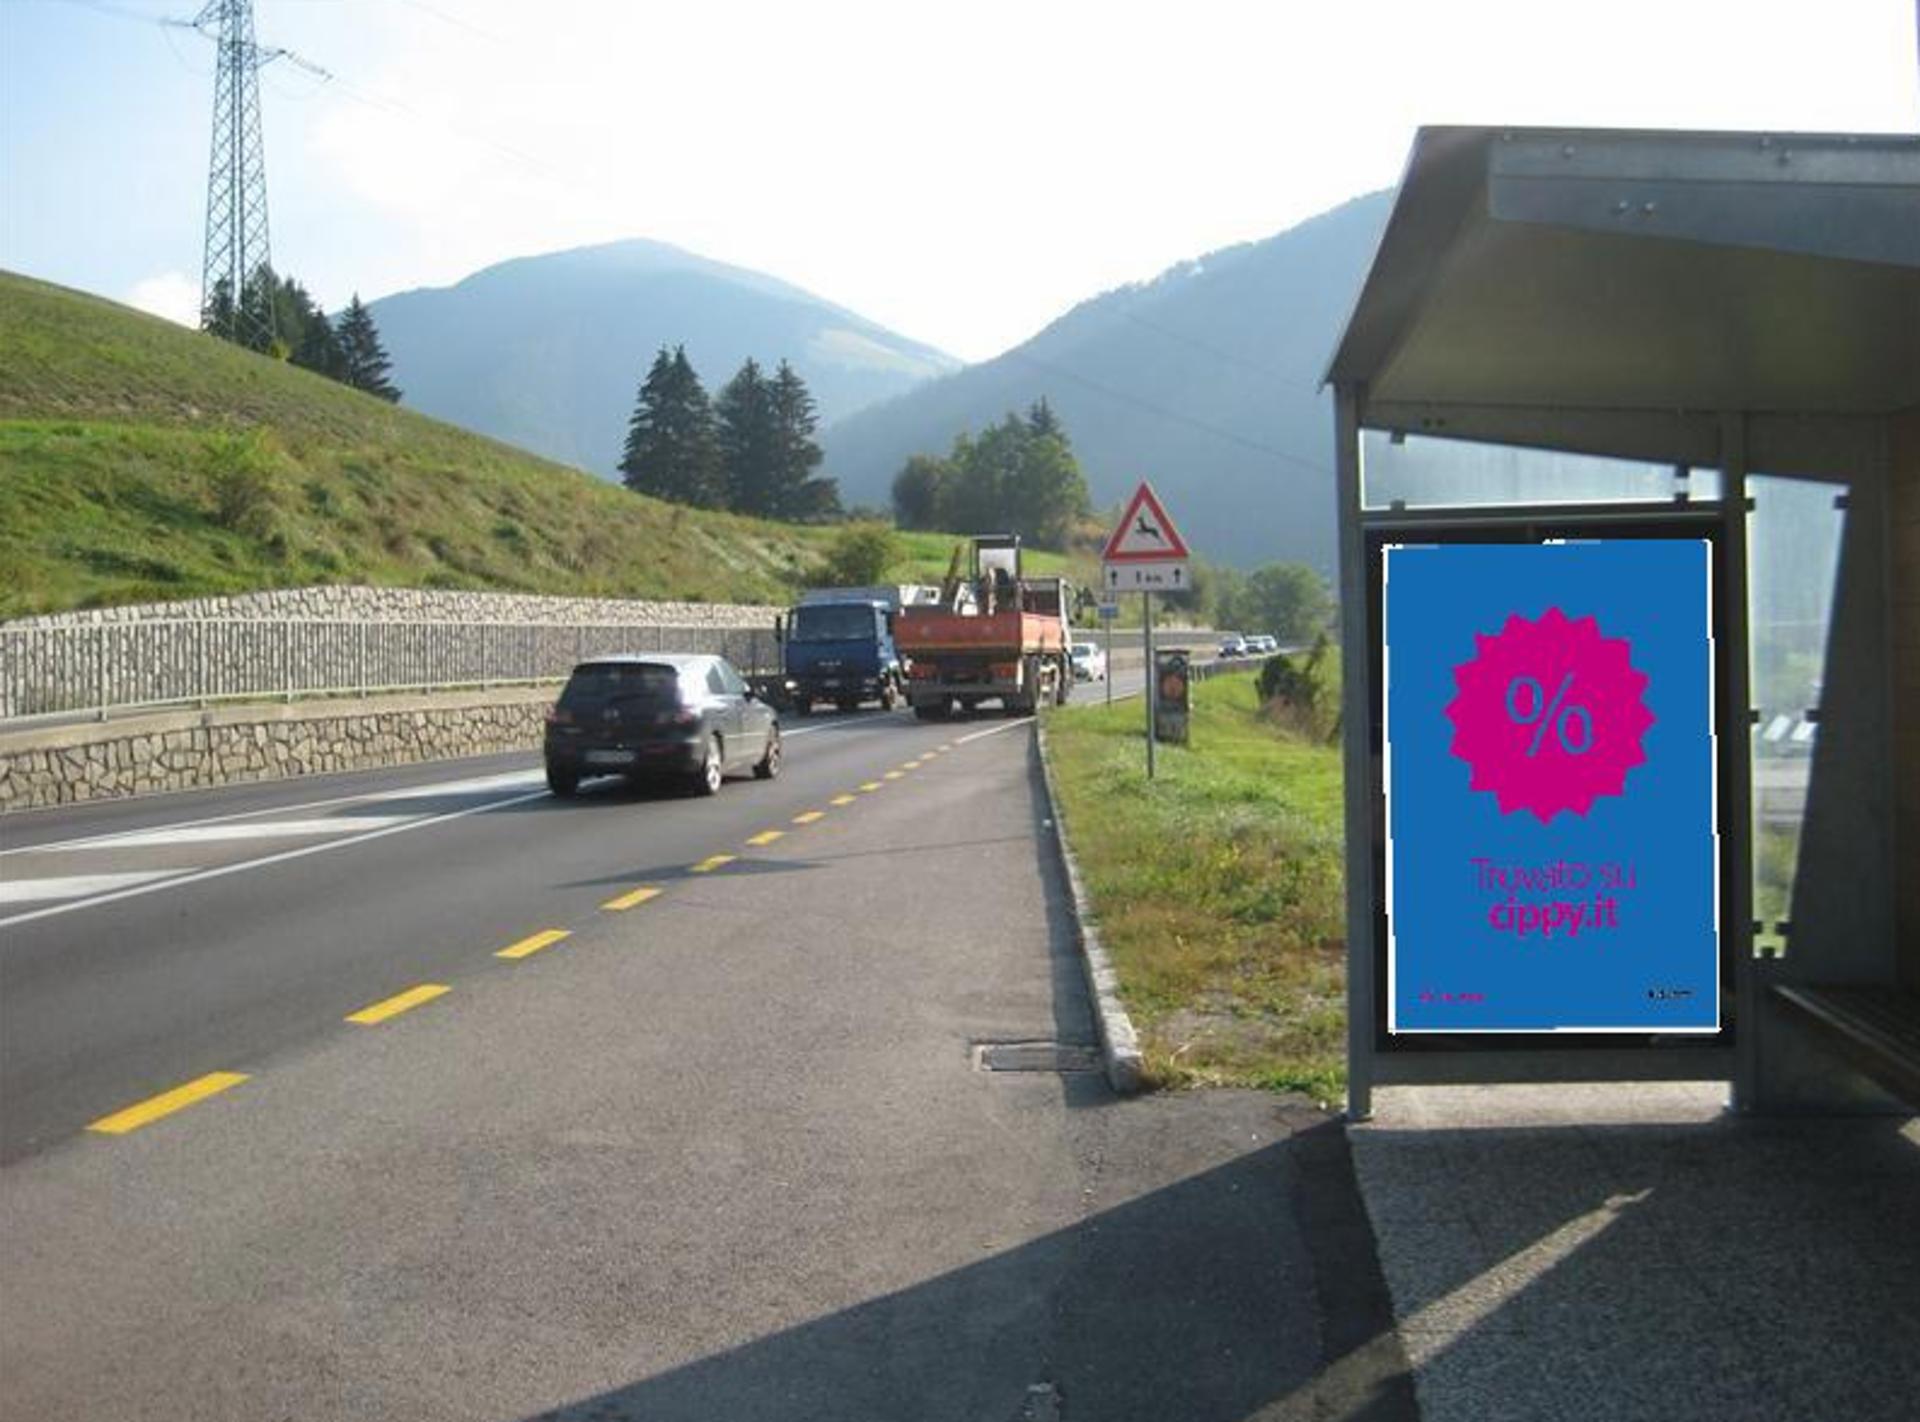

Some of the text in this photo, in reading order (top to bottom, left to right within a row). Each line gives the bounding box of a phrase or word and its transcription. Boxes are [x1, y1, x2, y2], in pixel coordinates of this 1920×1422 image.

[1506, 671, 1592, 756] %
[1600, 860, 1637, 889] su
[1488, 893, 1617, 937] cippy.it
